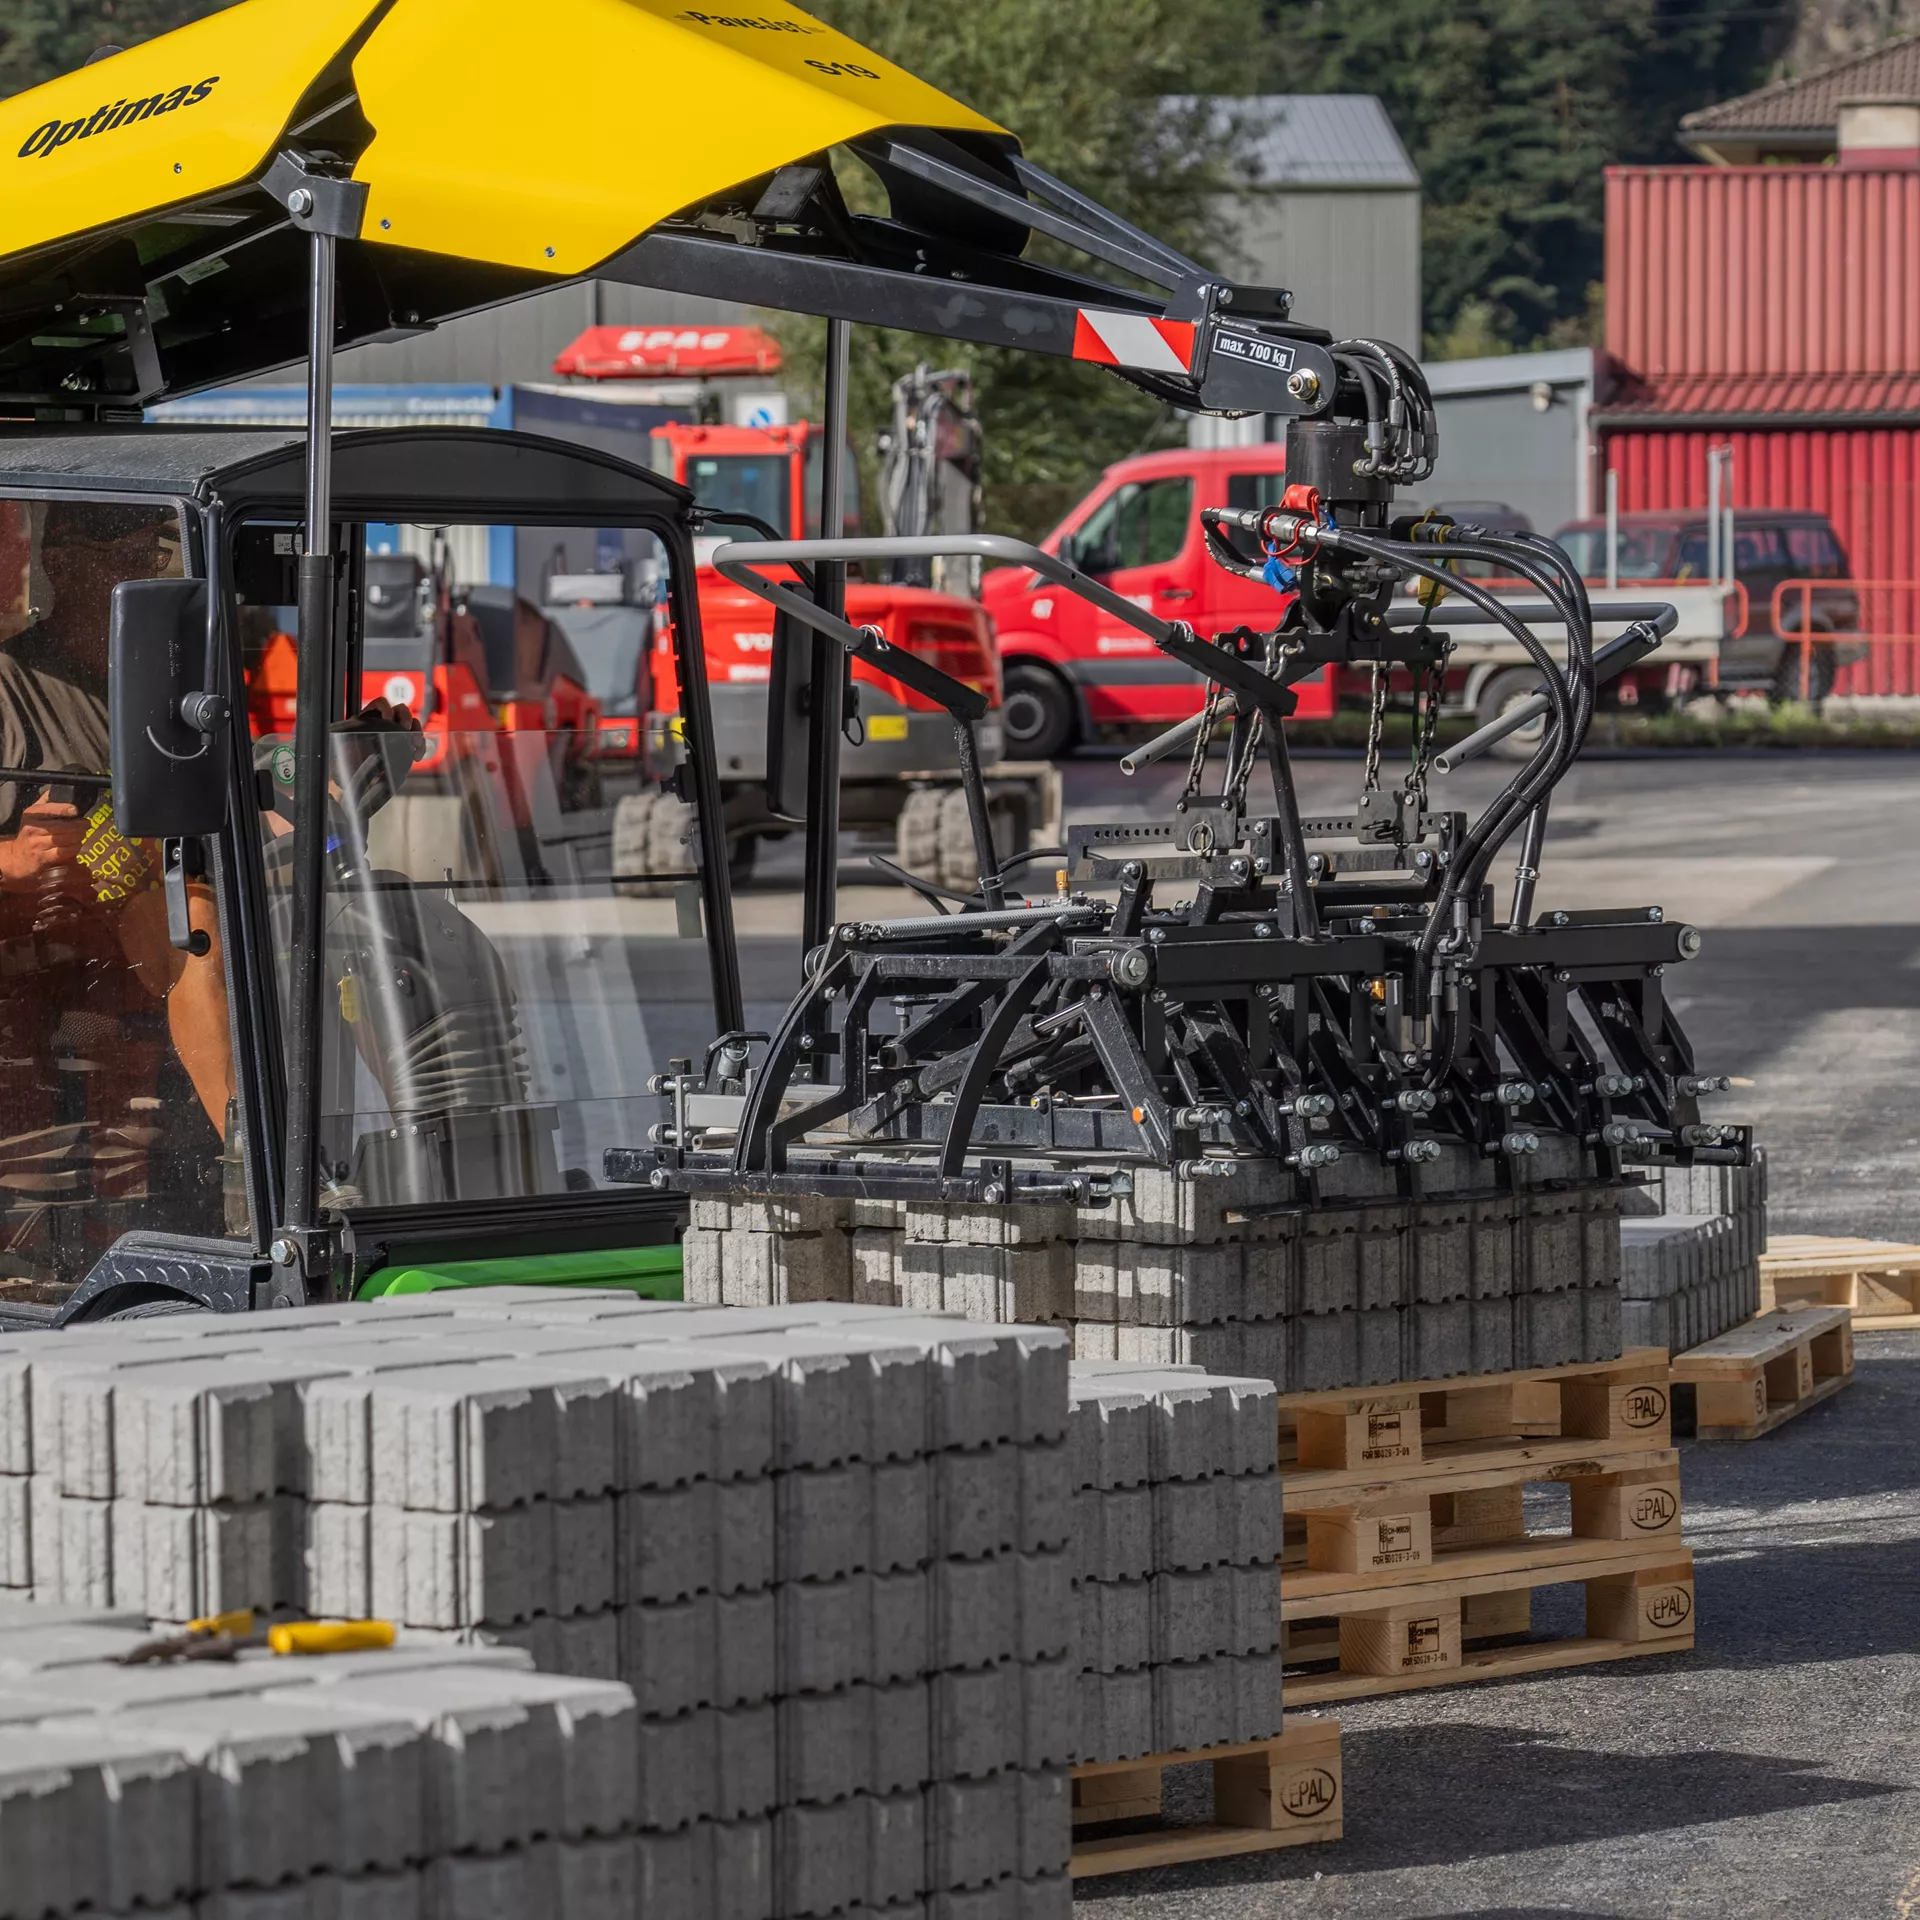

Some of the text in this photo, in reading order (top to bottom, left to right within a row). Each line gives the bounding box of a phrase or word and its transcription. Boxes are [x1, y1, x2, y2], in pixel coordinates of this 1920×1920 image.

[803, 59, 881, 80] S19
[17, 75, 220, 158] Optimas
[1220, 337, 1288, 368] max. 700 kg
[1626, 1395, 1660, 1420] EPAL
[1636, 1496, 1670, 1521] EPAL
[1372, 1555, 1384, 1565] FOR
[1653, 1594, 1685, 1620] EPAL
[1289, 1778, 1329, 1808] EPAL
